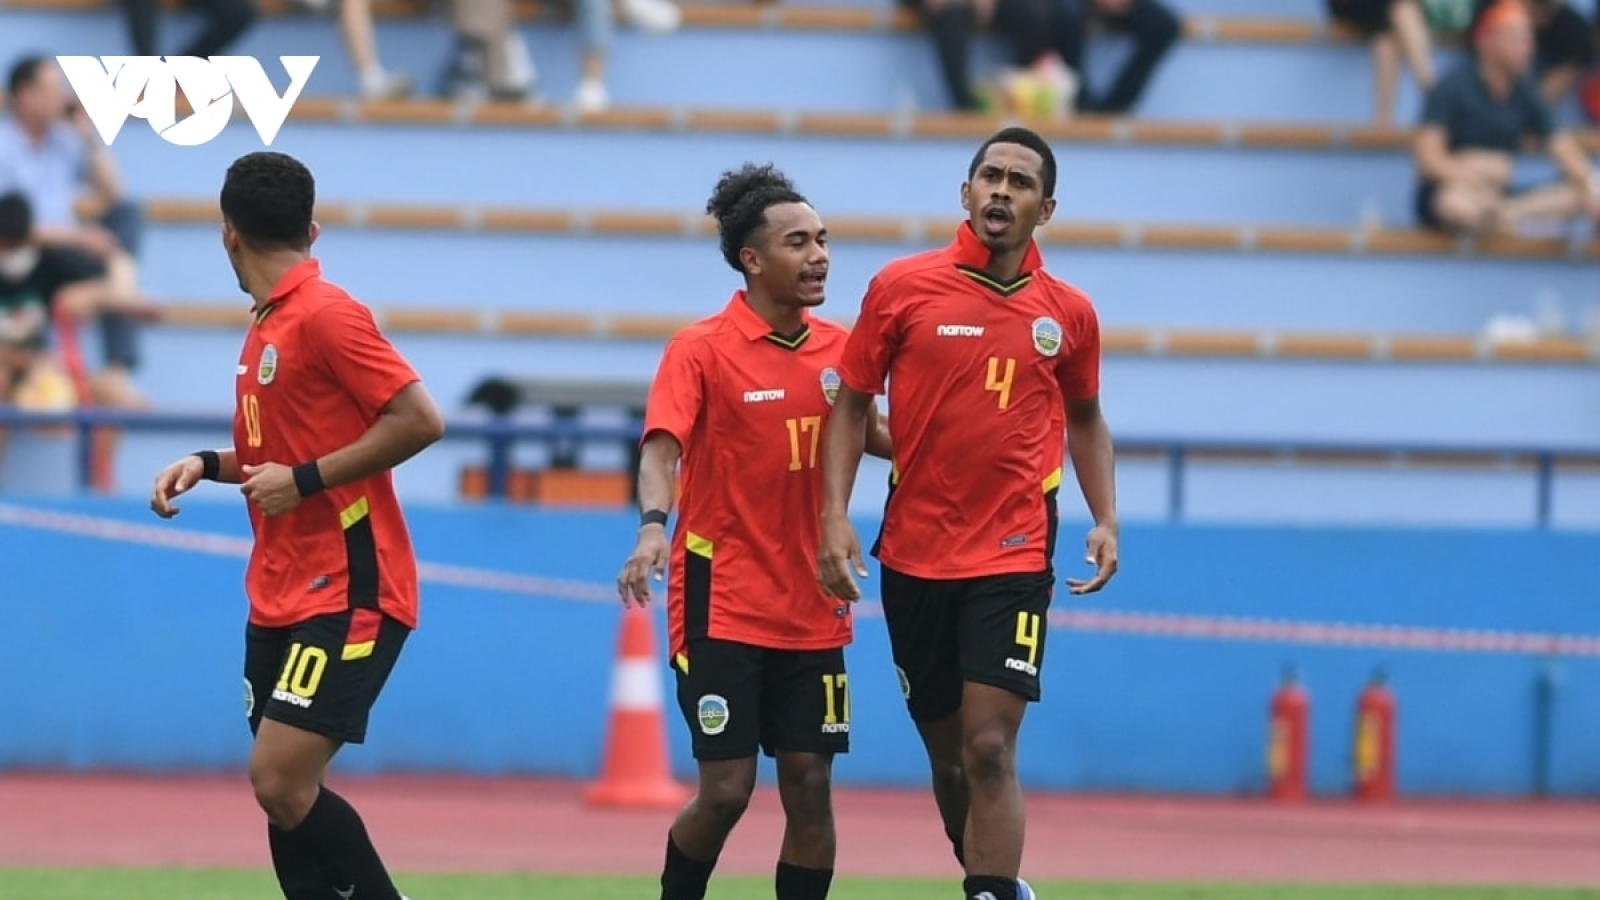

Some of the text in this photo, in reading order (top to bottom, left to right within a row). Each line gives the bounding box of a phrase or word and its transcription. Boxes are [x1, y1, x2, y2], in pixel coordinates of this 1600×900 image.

[937, 324, 984, 336] narrow
[743, 388, 785, 403] narrow
[985, 357, 1016, 409] 4
[243, 394, 262, 447] 10
[786, 415, 821, 471] 17
[1015, 611, 1040, 665] 4
[276, 643, 328, 697] 10
[822, 674, 849, 724] 17
